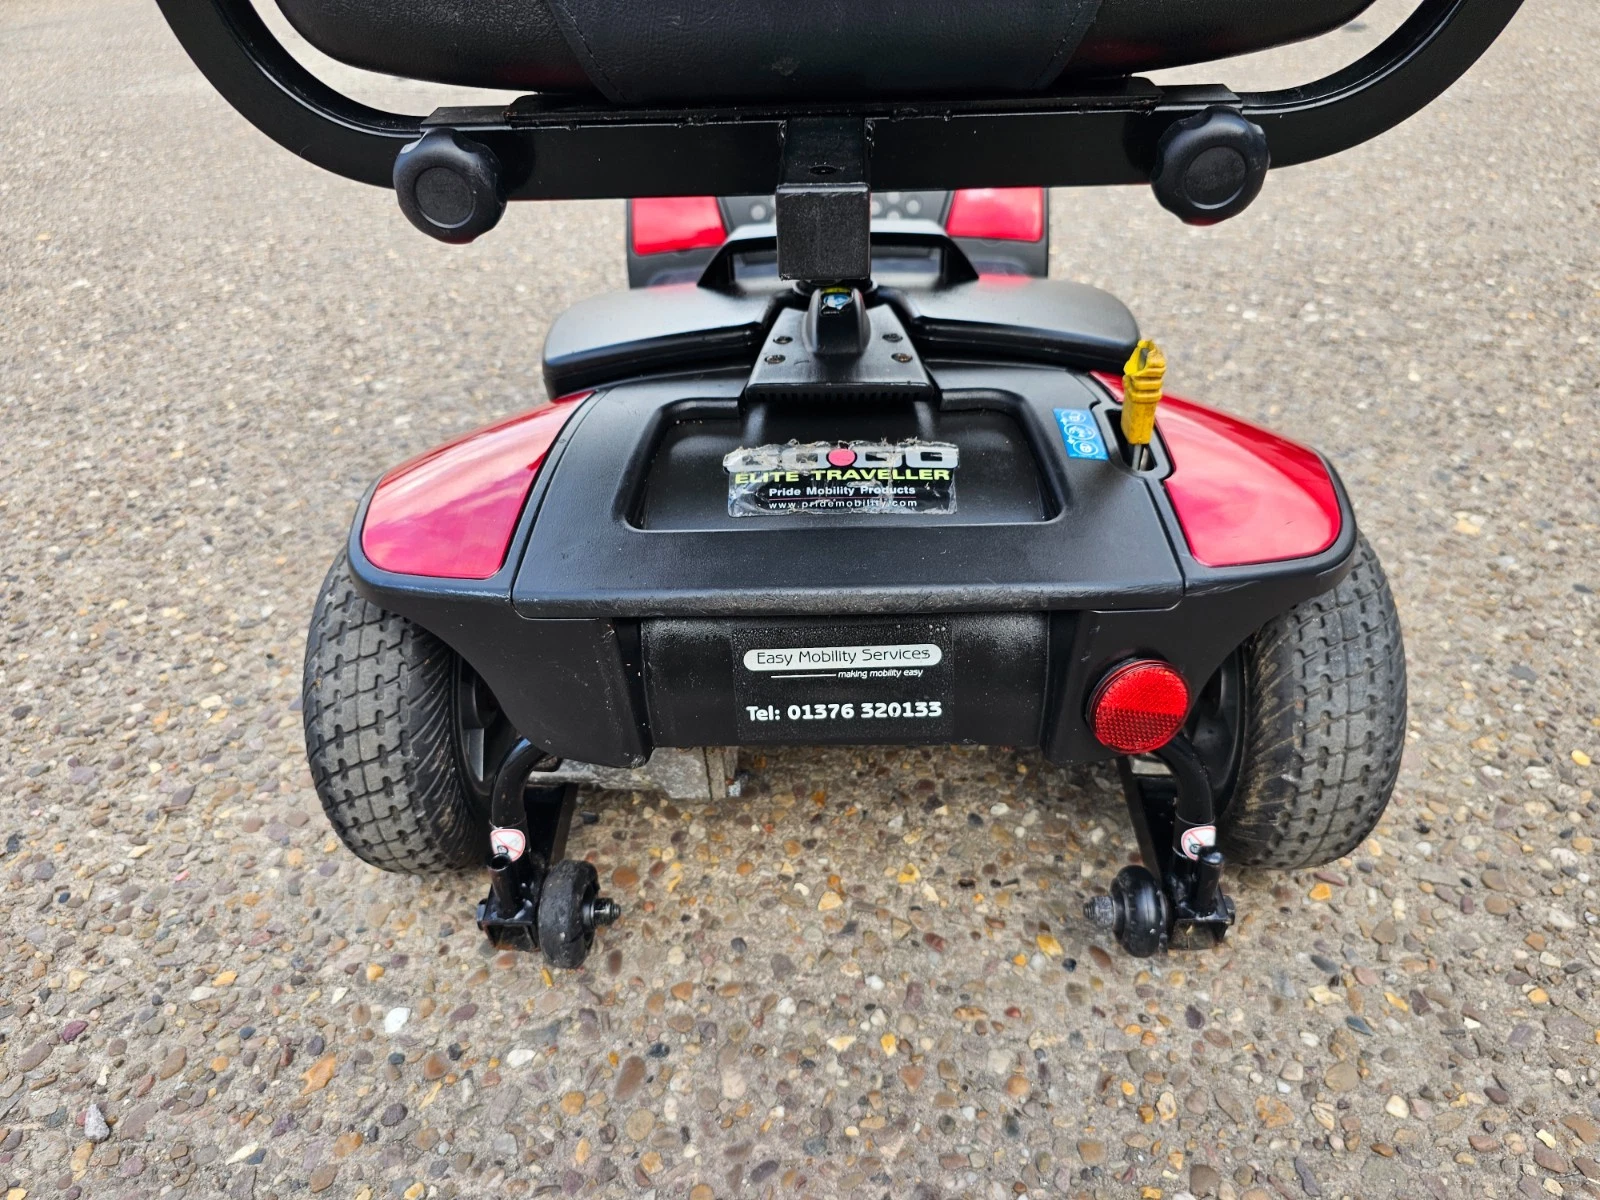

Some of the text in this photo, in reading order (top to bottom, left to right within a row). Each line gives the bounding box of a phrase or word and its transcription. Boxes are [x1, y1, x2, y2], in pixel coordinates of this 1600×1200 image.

[735, 469, 950, 484] ELITE TRAVELLER
[768, 485, 916, 497] Pride Mobility Products
[756, 647, 930, 666] Easy Mobility Services
[837, 669, 924, 680] making mobility easy
[746, 701, 943, 721] Tel: 01376 320133
